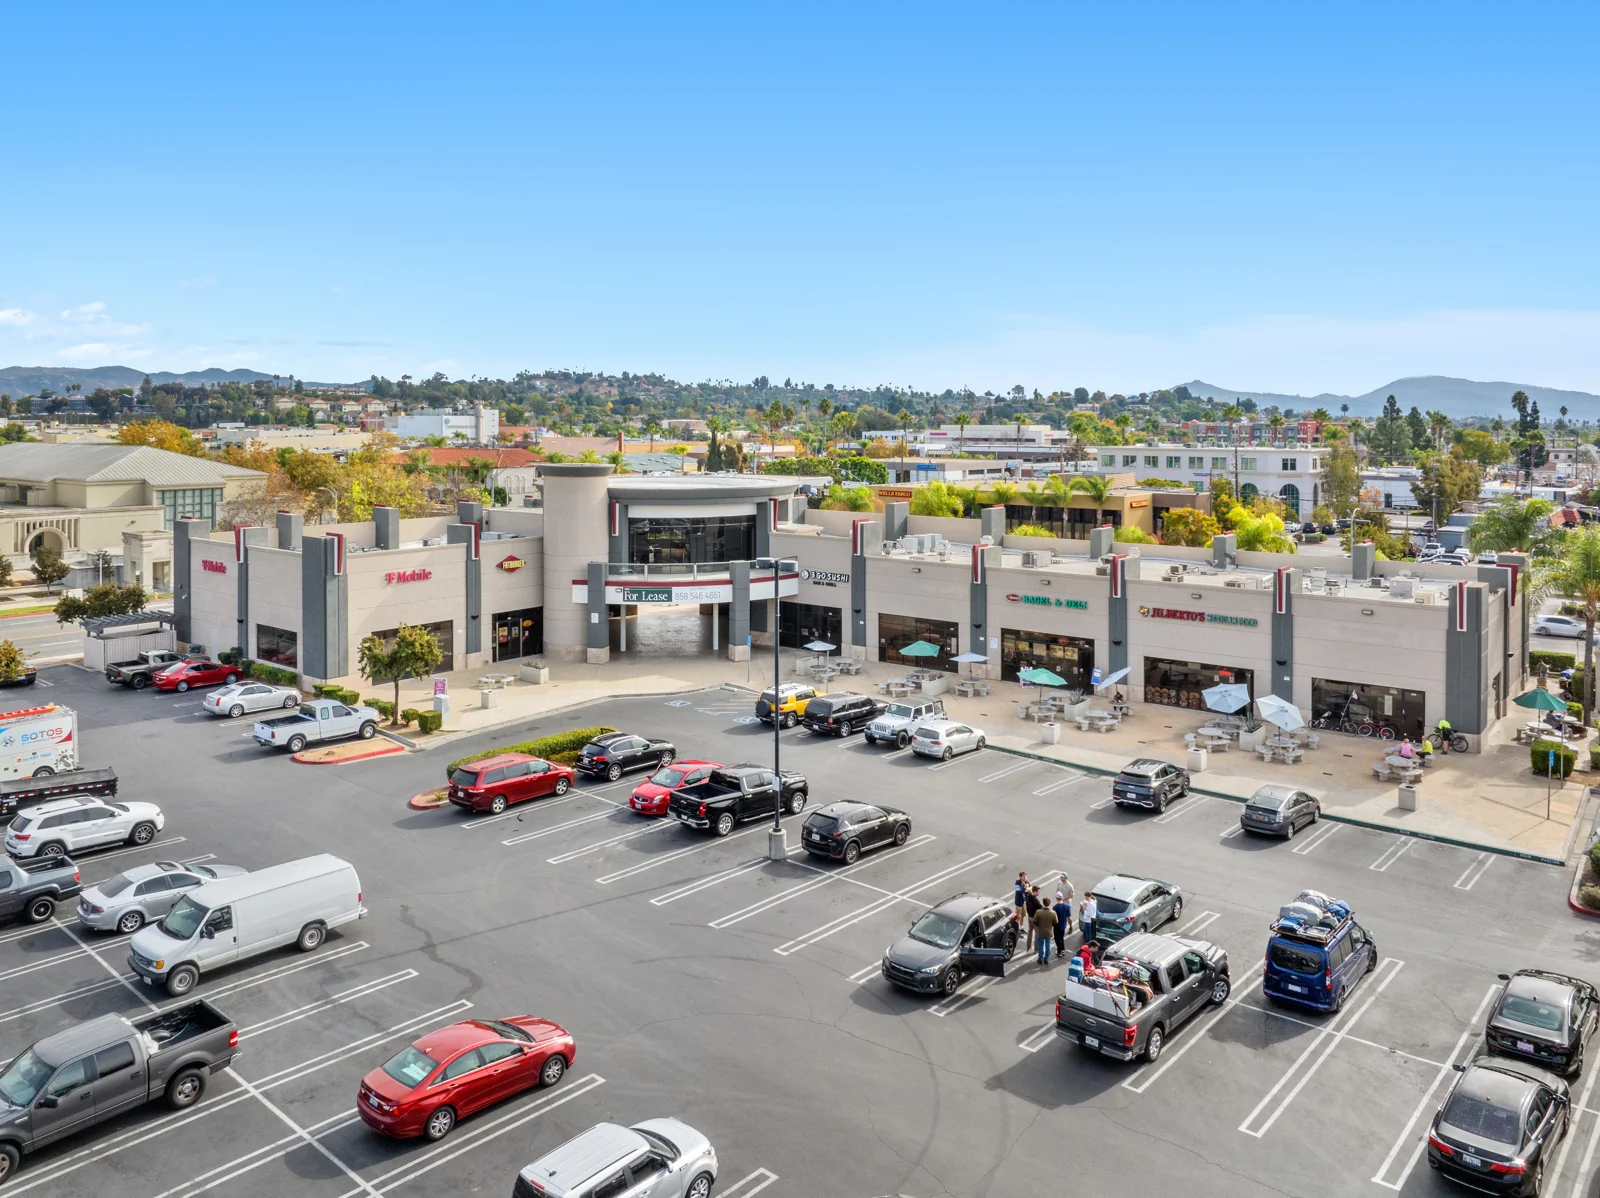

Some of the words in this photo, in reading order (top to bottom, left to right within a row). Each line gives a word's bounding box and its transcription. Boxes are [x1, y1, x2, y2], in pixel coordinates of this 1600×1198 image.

[827, 572, 850, 583] SUSHI
[623, 590, 639, 601] For
[642, 590, 668, 601] Lease
[674, 592, 688, 601] 858
[690, 591, 703, 601] 546
[704, 591, 721, 600] 4651
[1022, 594, 1052, 606] BAGEL
[1054, 598, 1063, 608] &
[1065, 599, 1088, 610] DELI
[1151, 607, 1206, 623] JILBERTO'S
[21, 727, 63, 742] SOTOS
